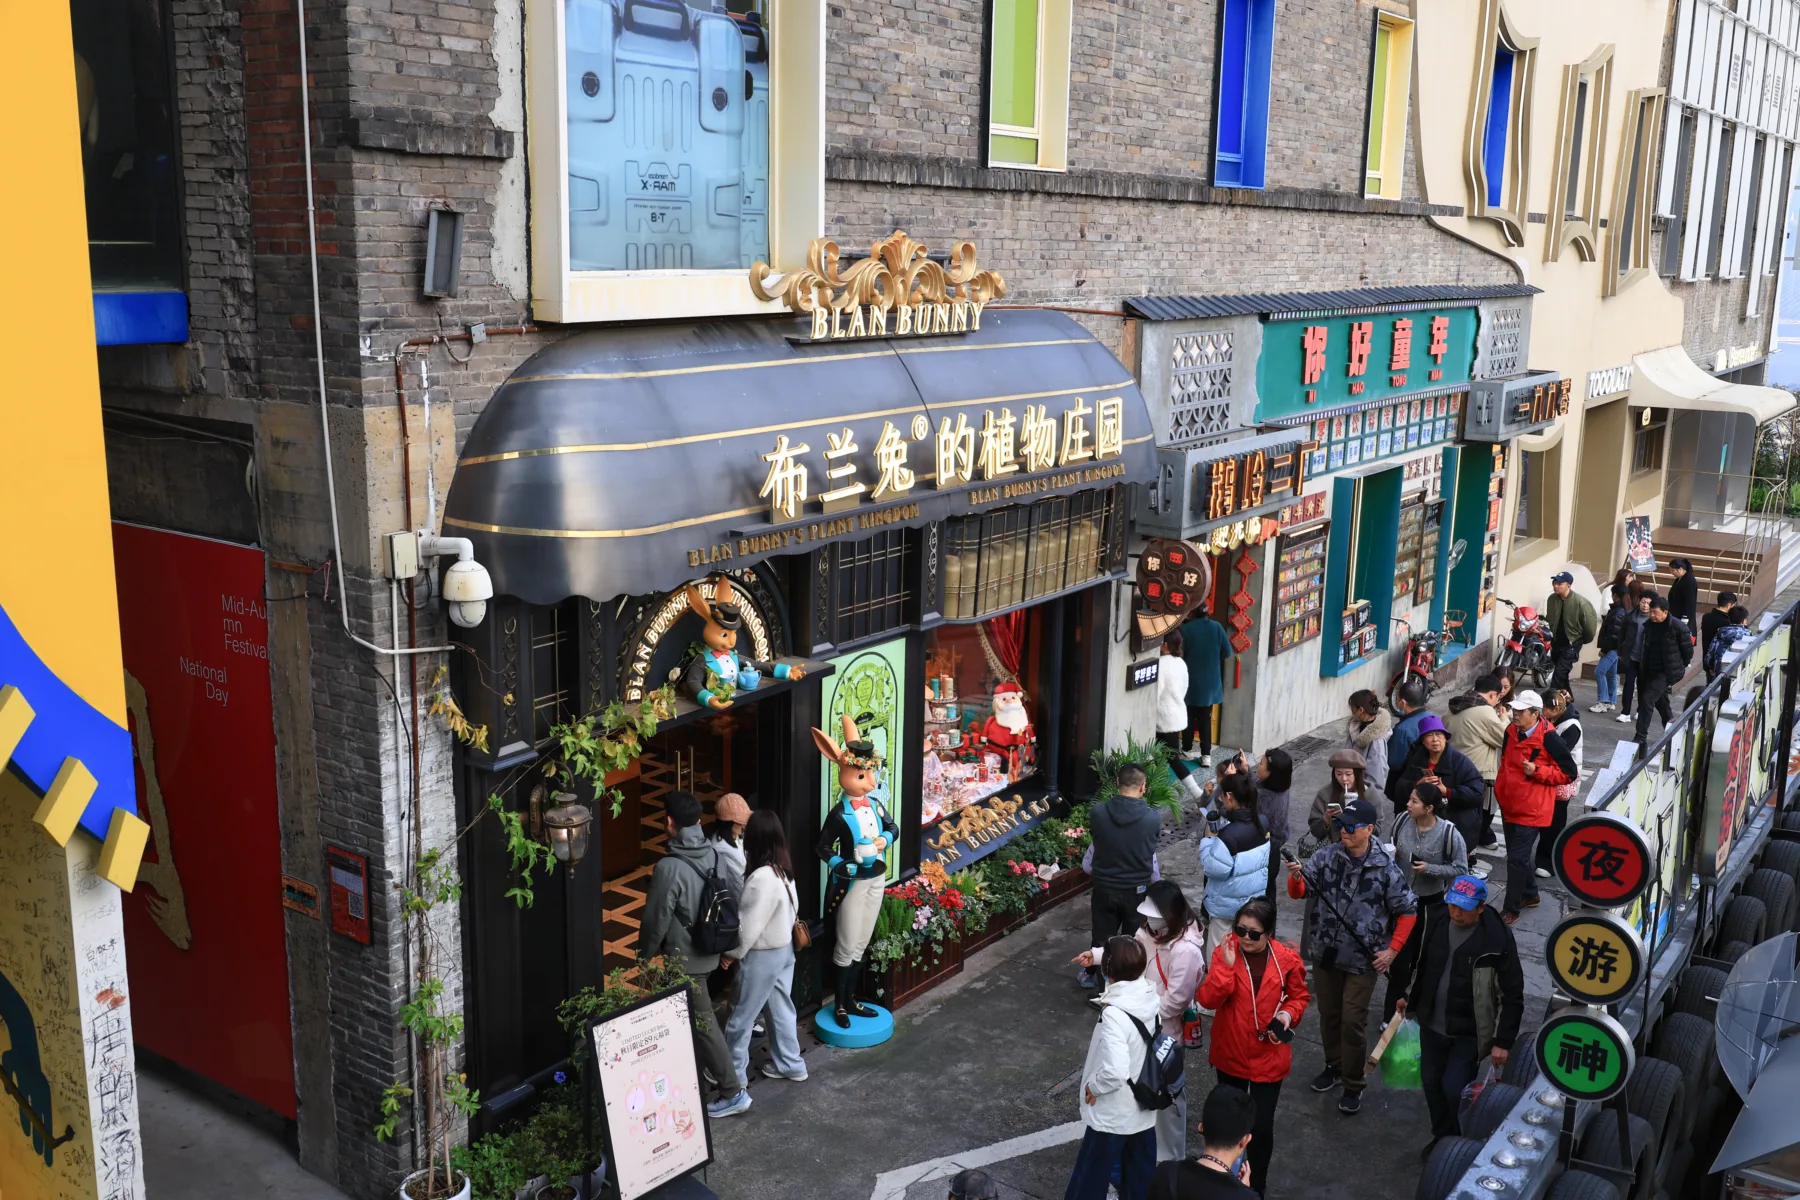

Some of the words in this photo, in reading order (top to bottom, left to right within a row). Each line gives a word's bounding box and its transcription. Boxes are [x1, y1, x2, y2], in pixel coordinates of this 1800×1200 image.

[810, 305, 888, 339] BLAN
[895, 302, 984, 335] BUNNY
[1301, 316, 1450, 385] 你好童年
[1349, 381, 1365, 395] HAO
[968, 488, 999, 505] BLAN
[1003, 478, 1047, 498] BUNNY'S
[1051, 471, 1081, 489] PLANT
[688, 543, 733, 567] BLAN
[737, 528, 804, 556] BUNNY'S
[808, 517, 854, 541] PLANT
[858, 503, 920, 530] KINGDOM
[180, 656, 227, 684] National
[627, 641, 653, 701] BLAN
[206, 681, 229, 707] Day
[966, 813, 1019, 850] BUNNY
[1577, 840, 1629, 886] 夜
[1568, 935, 1619, 984] 游
[1556, 1033, 1608, 1082] 神
